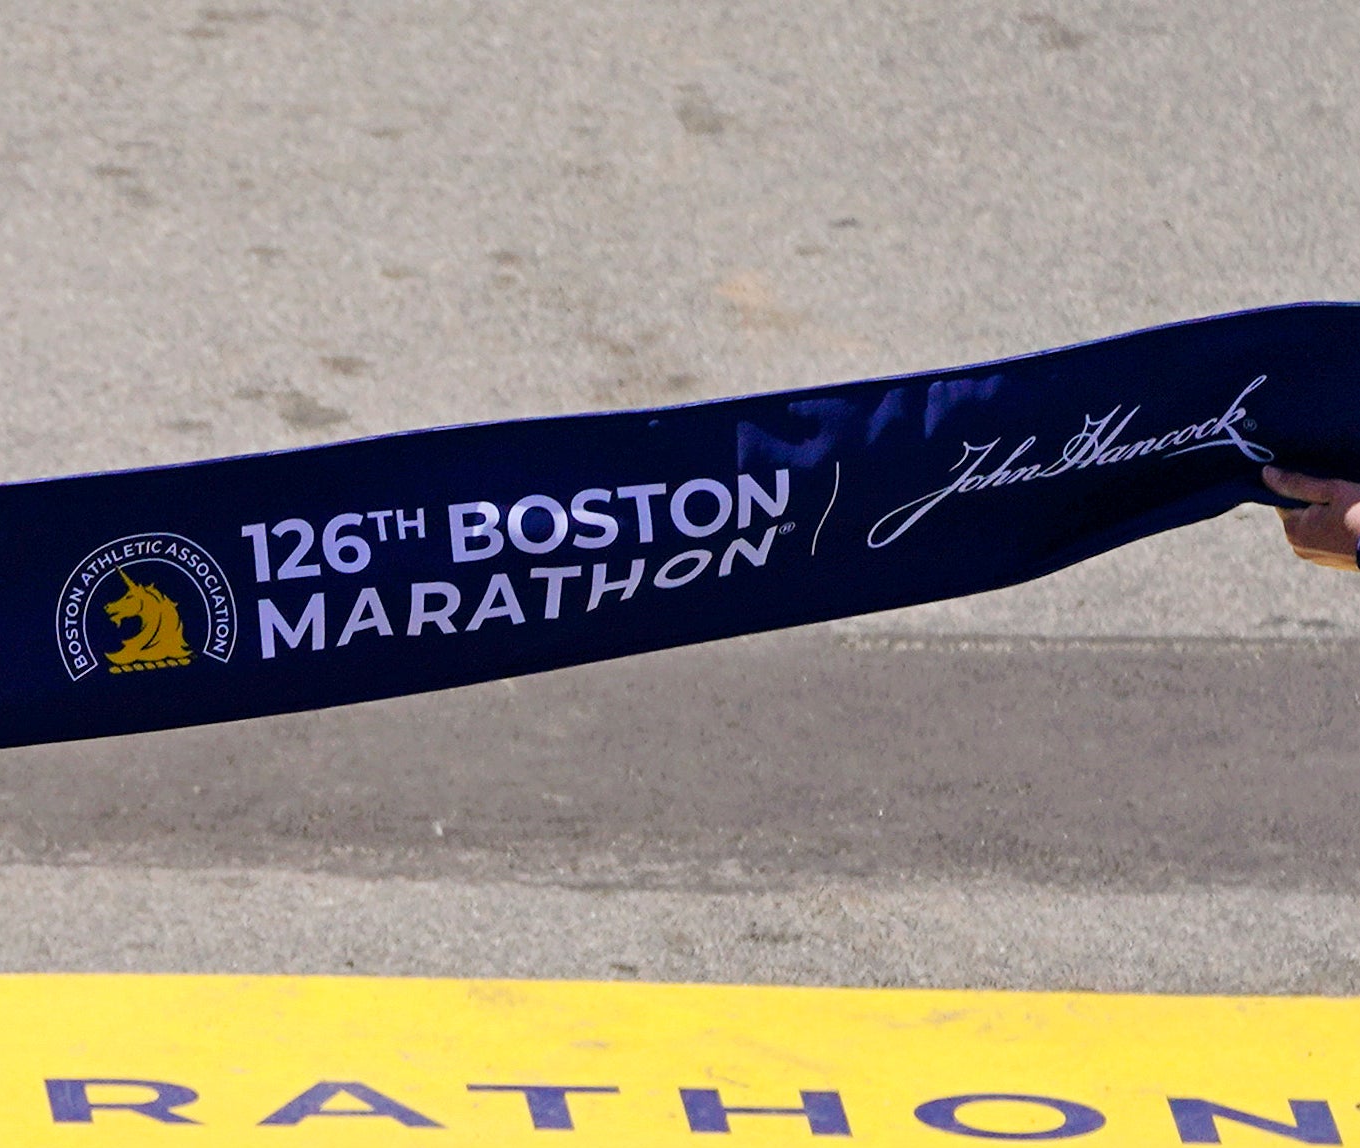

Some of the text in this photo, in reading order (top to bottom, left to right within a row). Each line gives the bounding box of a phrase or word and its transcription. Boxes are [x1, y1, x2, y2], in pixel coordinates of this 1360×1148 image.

[240, 468, 792, 583] 126TH BOSTON
[867, 436, 1043, 549] John
[64, 539, 230, 670] BOSTON ATHLETIC ASSOCIATION
